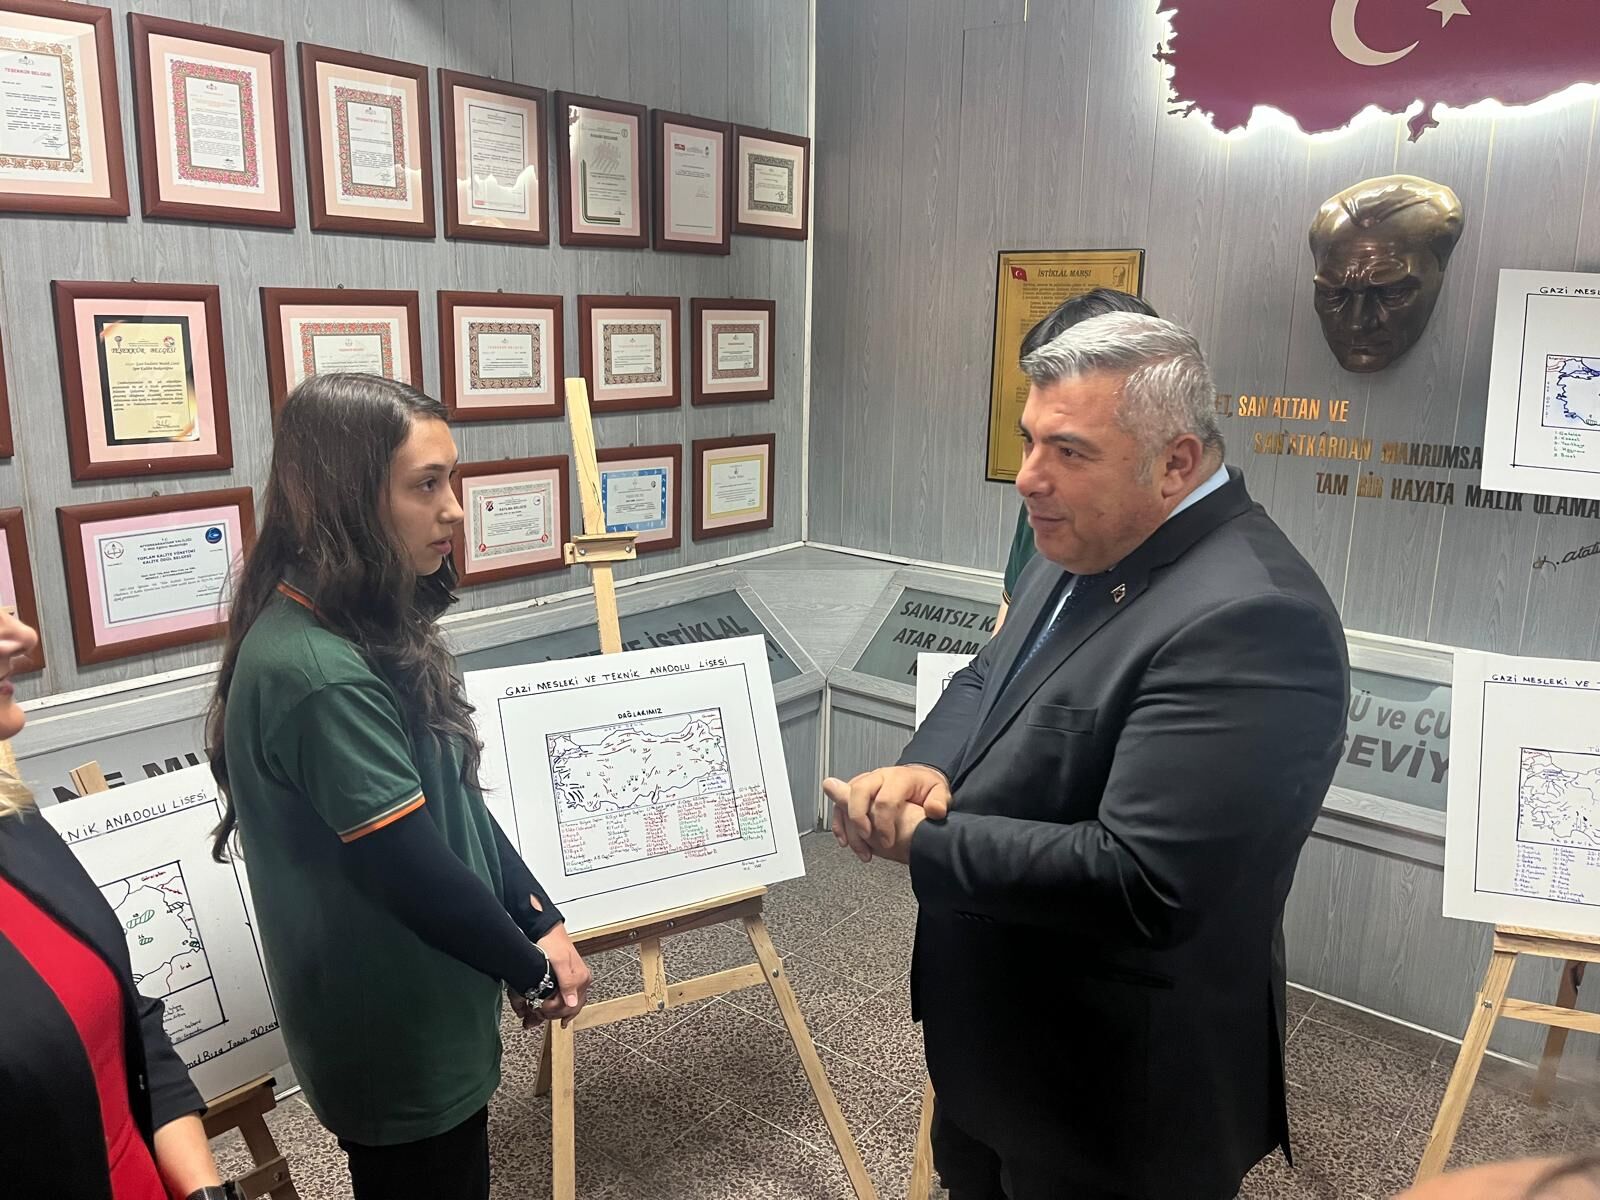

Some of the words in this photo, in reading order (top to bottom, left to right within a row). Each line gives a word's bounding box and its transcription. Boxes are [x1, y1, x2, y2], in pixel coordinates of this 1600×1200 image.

[1328, 400, 1350, 422] VE
[1380, 442, 1482, 470] MAHRUMSA
[1316, 472, 1348, 496] TAM
[1391, 478, 1454, 505] HAYATA
[900, 601, 980, 628] SANATSIZ
[892, 628, 937, 650] ATAR
[936, 636, 980, 655] DAM
[584, 675, 596, 683] VE
[650, 663, 690, 675] ANADOLU
[618, 708, 663, 719] DAĞLARIMIZ
[1377, 706, 1406, 730] ve
[1341, 734, 1450, 784] EVİY
[106, 803, 166, 830] ANADOLU
